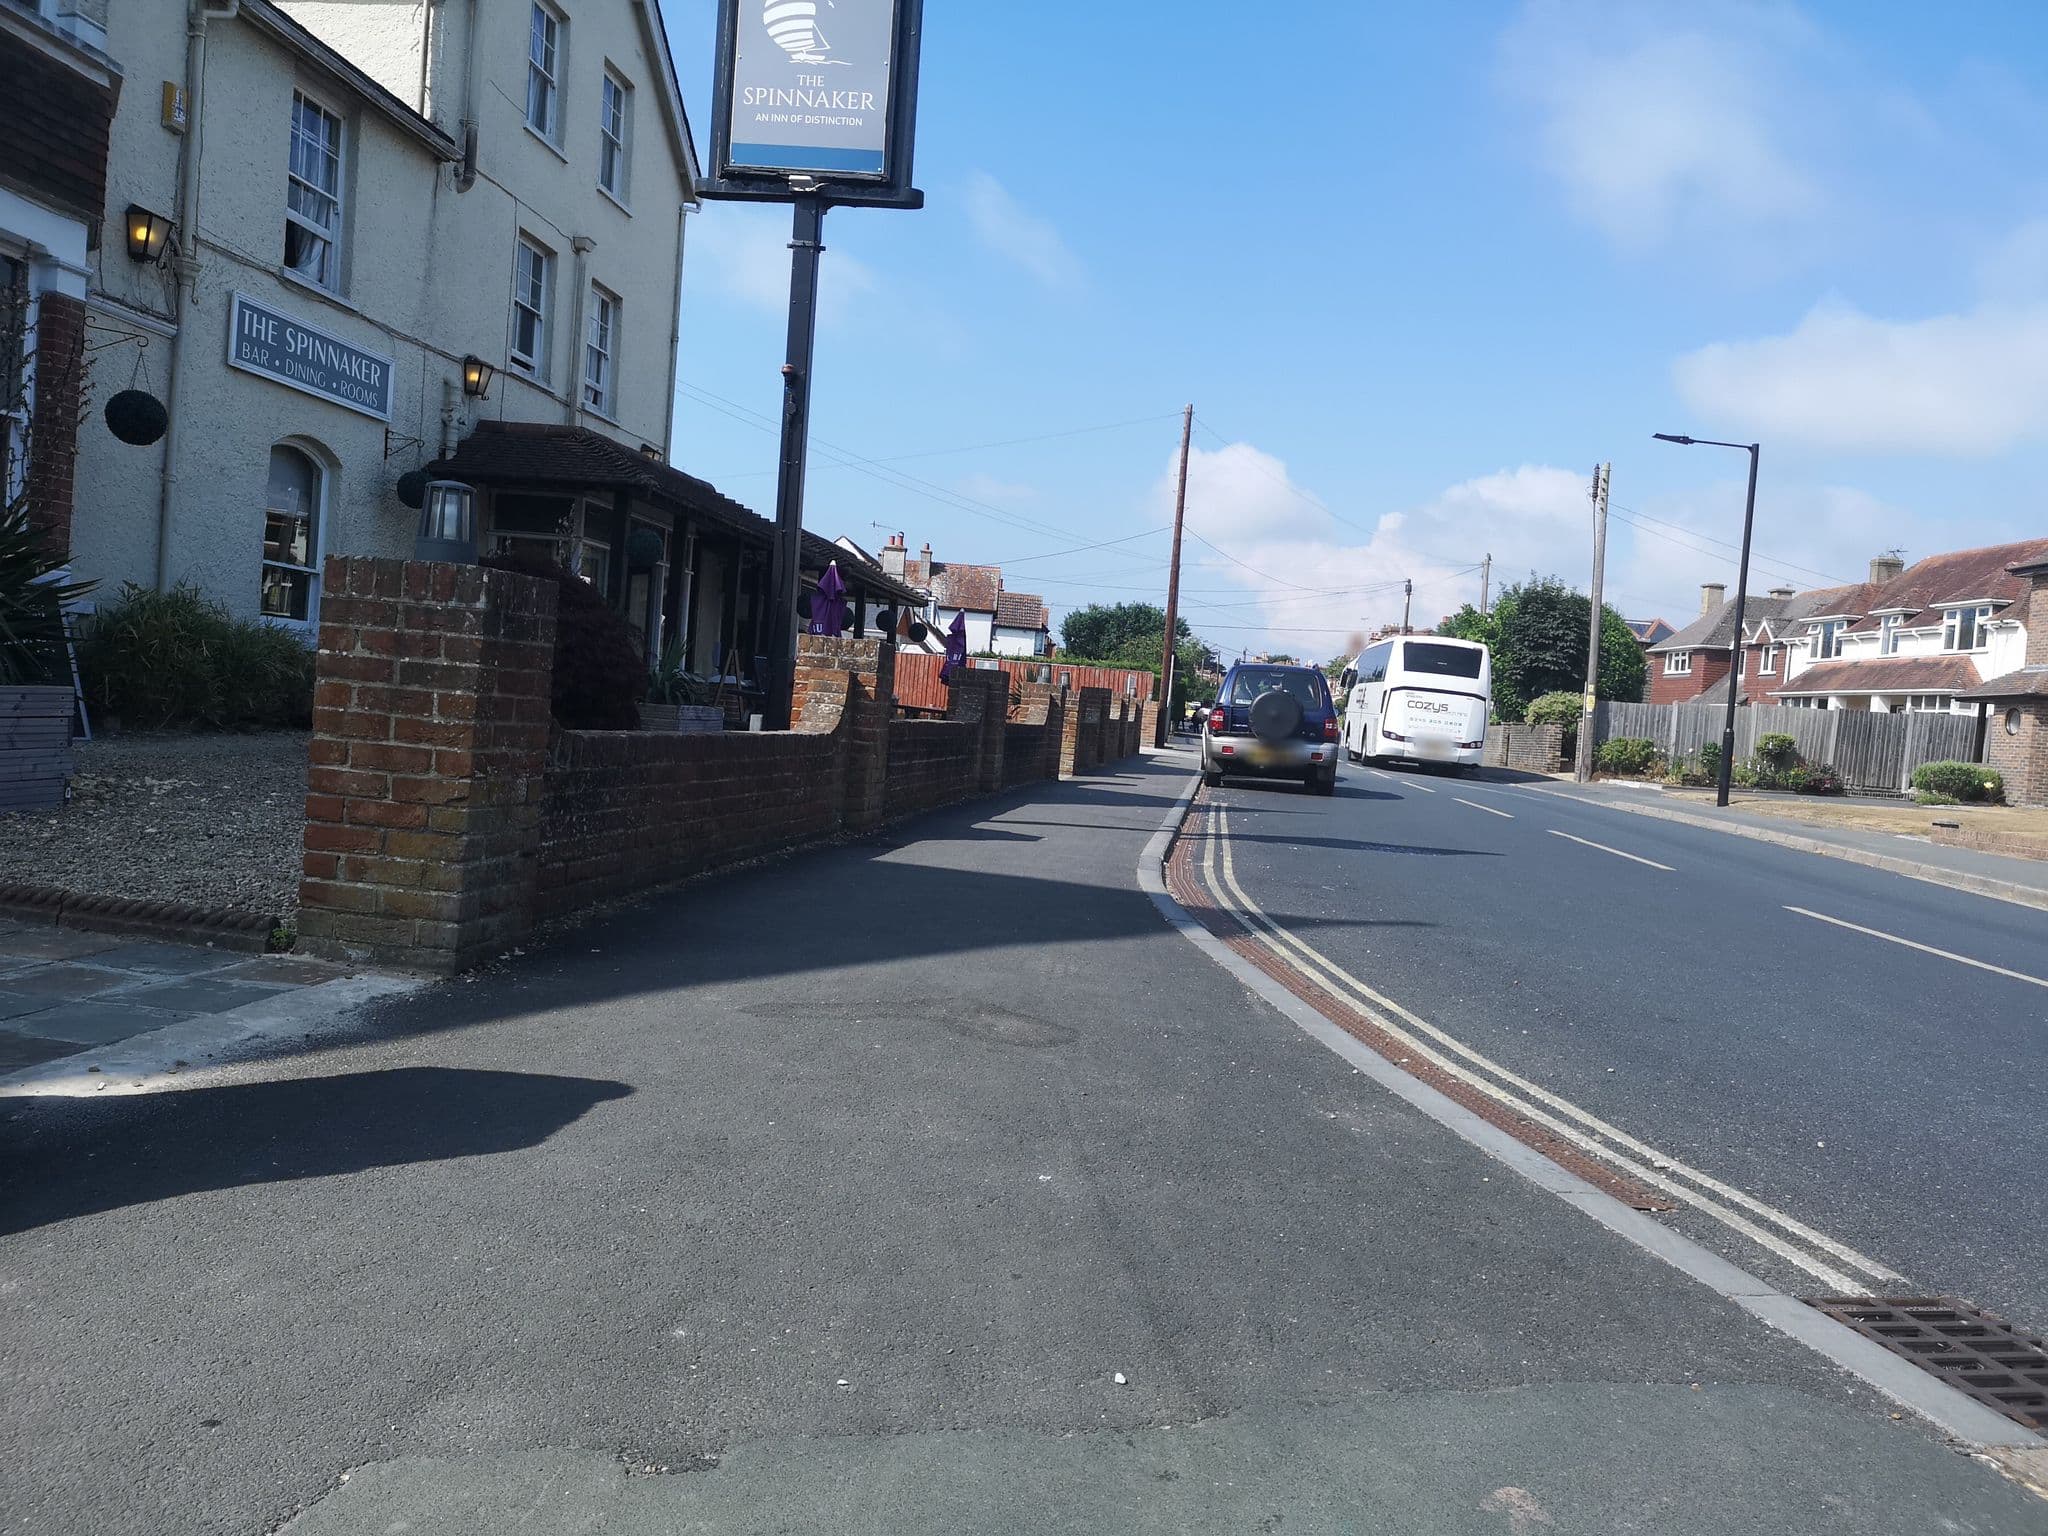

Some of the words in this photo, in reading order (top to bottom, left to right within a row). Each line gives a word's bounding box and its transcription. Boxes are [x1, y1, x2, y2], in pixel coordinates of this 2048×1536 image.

[797, 74, 825, 87] THE
[743, 87, 876, 111] SPINNAKER
[755, 113, 769, 122] AN
[771, 114, 788, 123] INN
[790, 115, 803, 123] OF
[805, 115, 863, 126] DISTINCTION
[242, 308, 278, 346] THE
[285, 327, 381, 387] SPINNAKER
[242, 342, 269, 366] BAR
[285, 359, 326, 388] DINING
[340, 380, 378, 408] ROOMS
